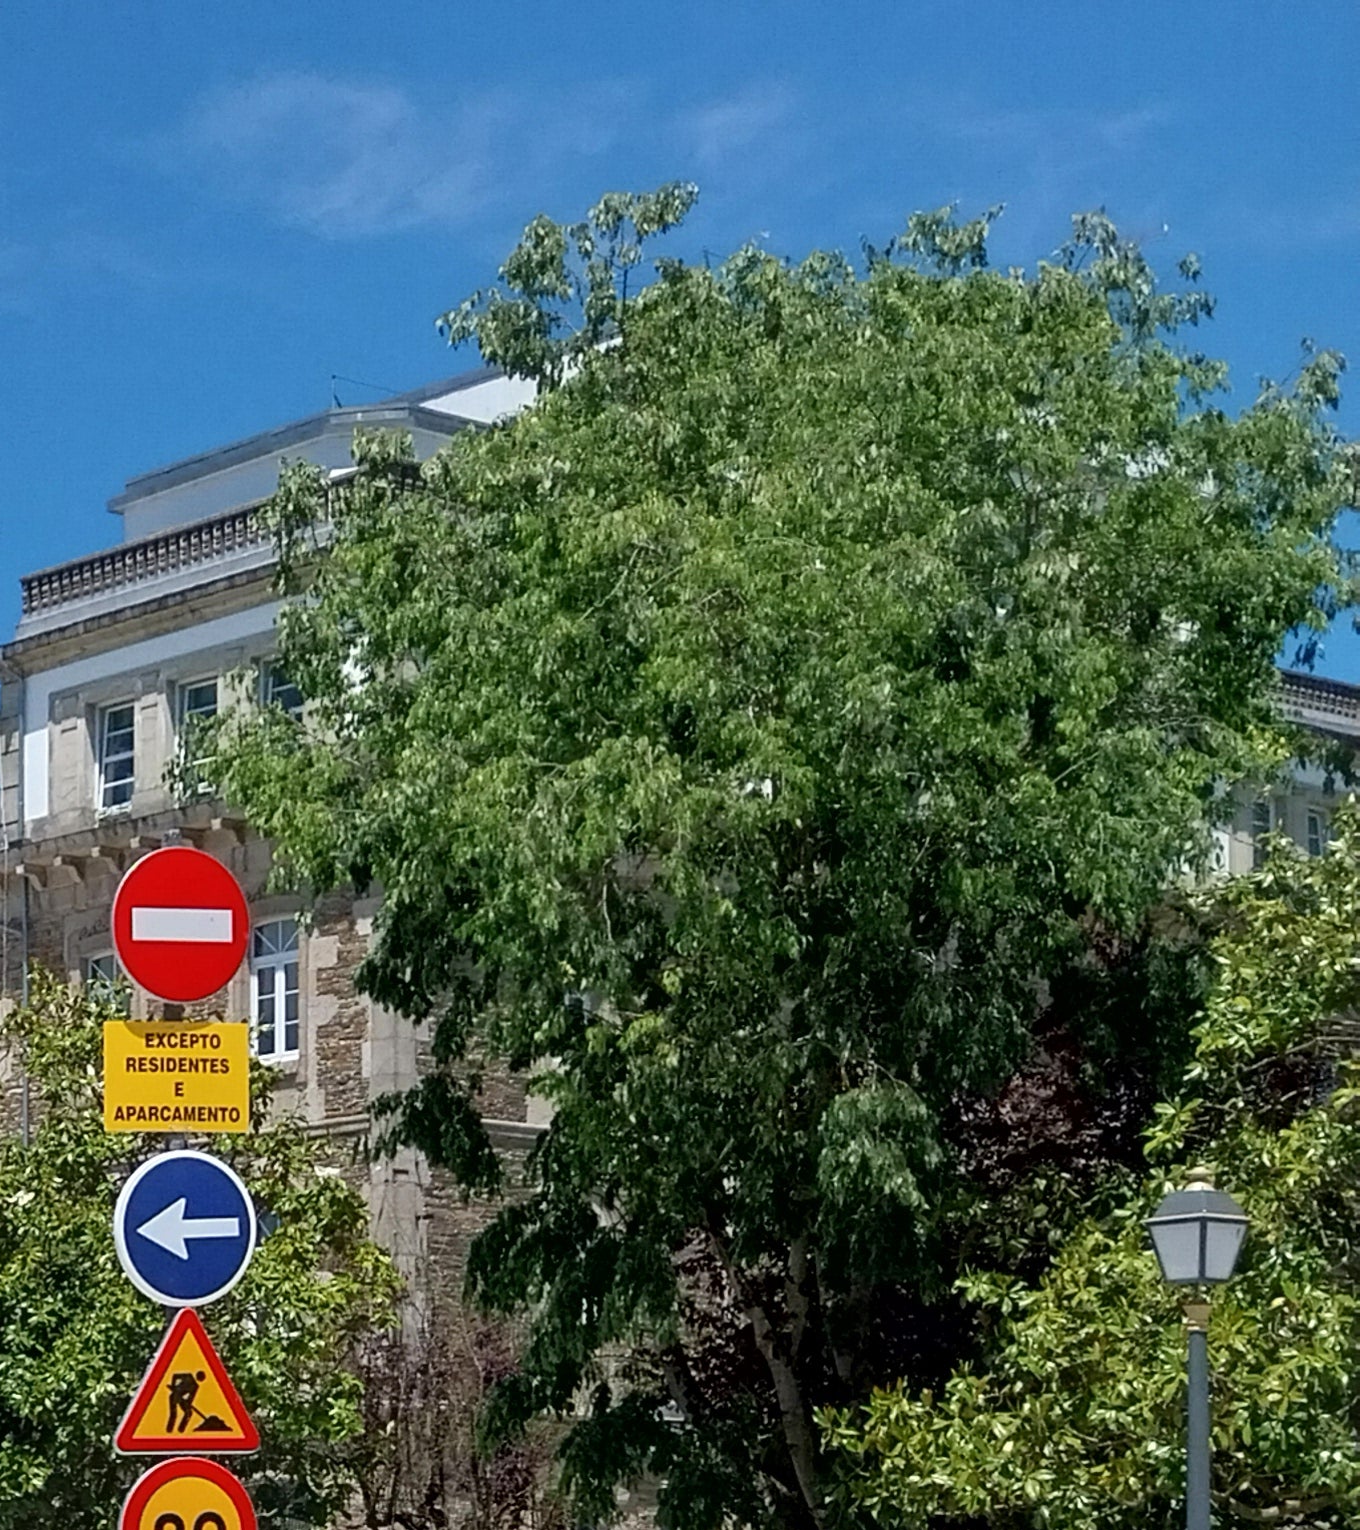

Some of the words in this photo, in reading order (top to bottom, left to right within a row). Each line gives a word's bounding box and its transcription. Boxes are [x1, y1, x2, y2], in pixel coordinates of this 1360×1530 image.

[145, 1032, 221, 1049] EXCEPTO
[126, 1057, 229, 1074] RESIDENTES
[174, 1082, 184, 1097] E
[114, 1106, 240, 1123] APARCAMENTO
